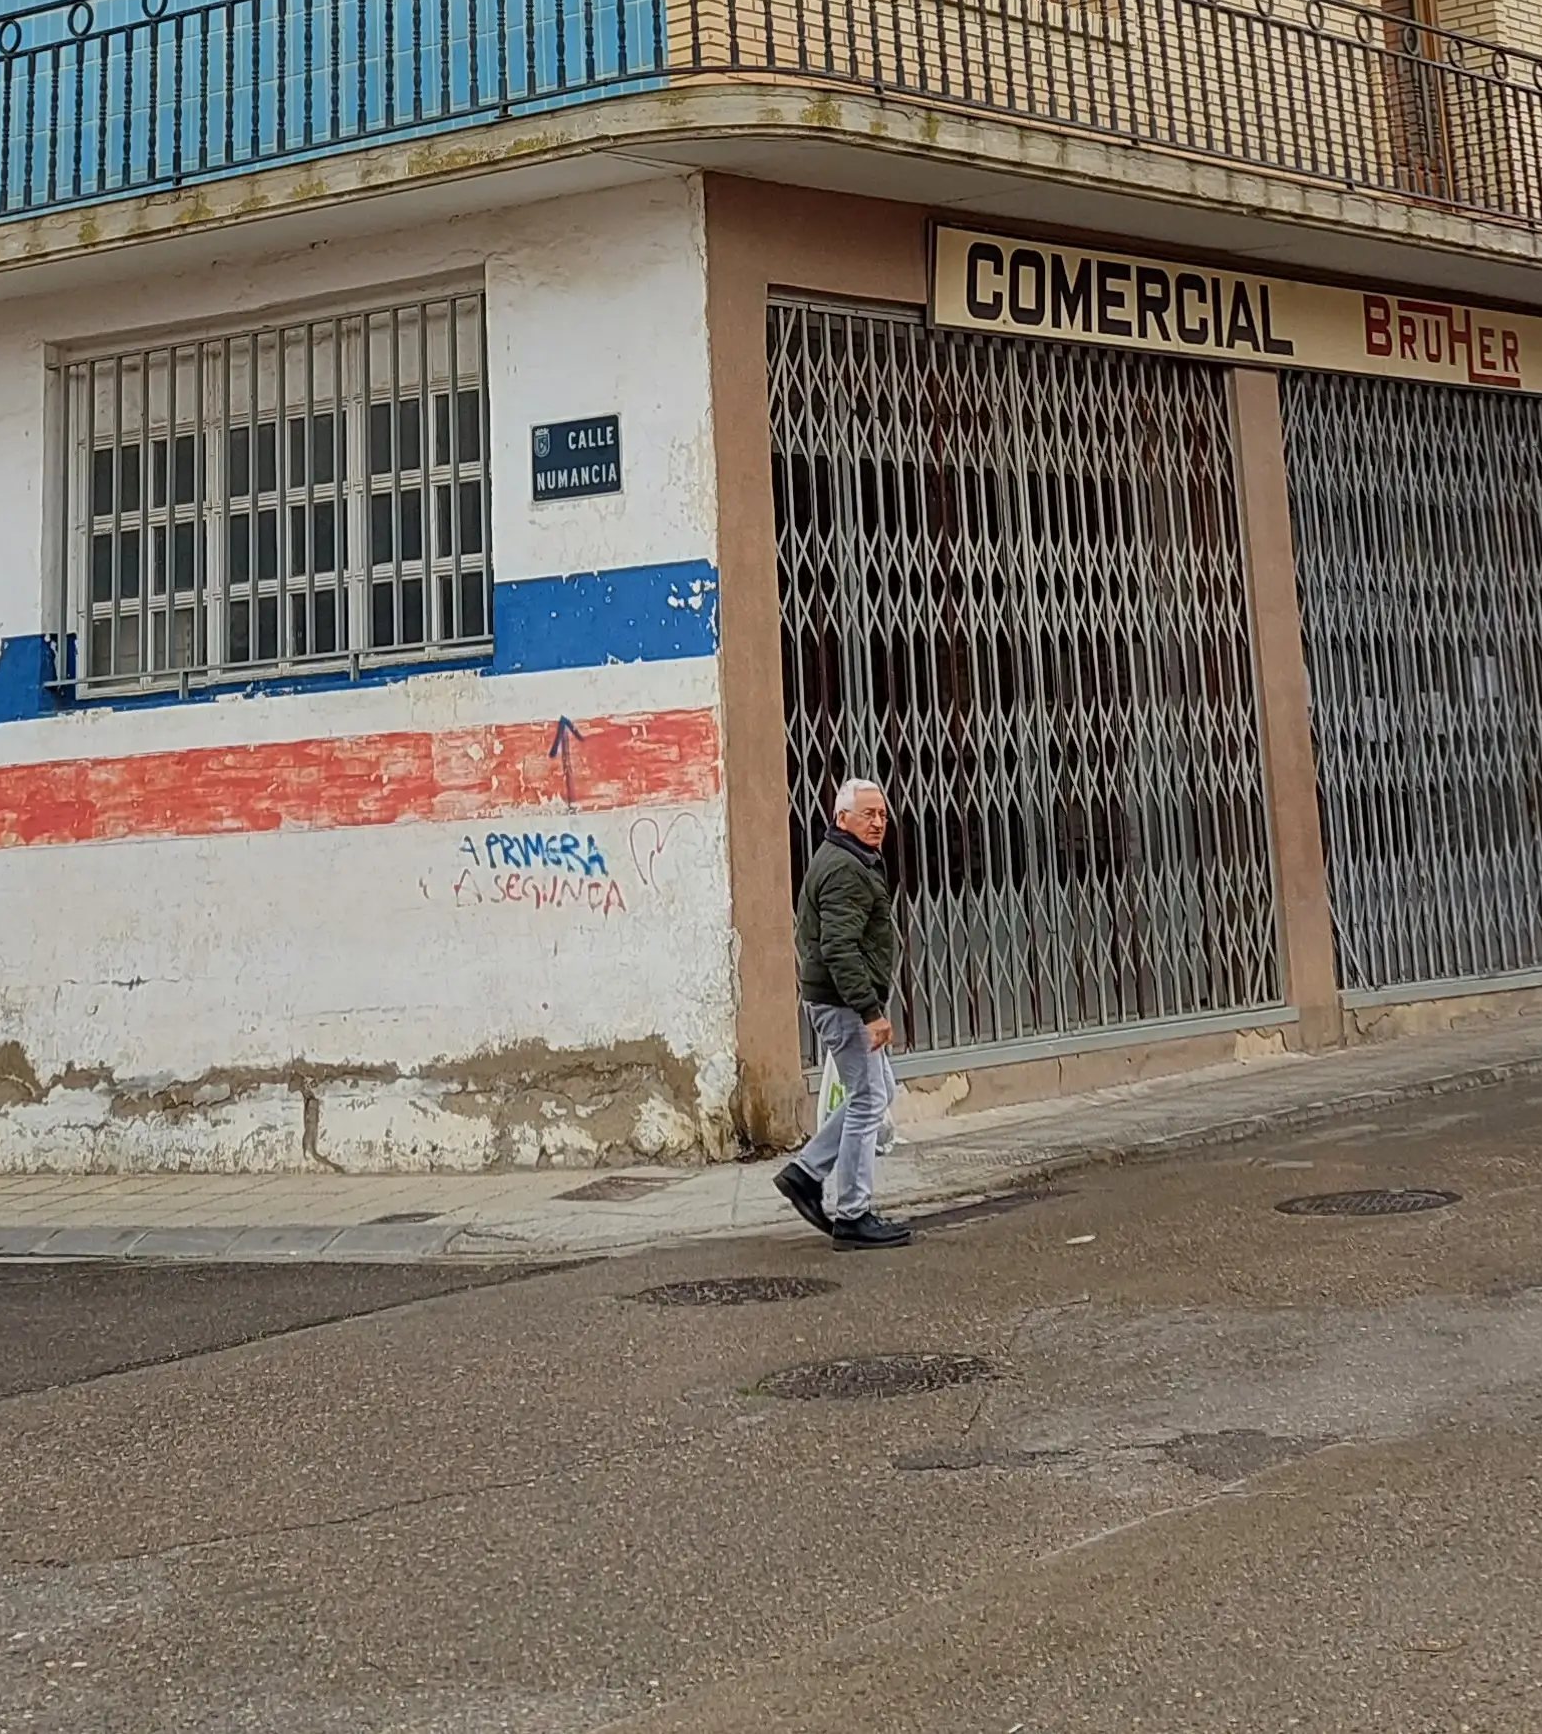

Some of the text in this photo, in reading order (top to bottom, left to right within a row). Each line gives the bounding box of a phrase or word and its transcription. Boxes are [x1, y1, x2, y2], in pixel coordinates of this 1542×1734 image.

[965, 241, 1294, 357] COMERCIAL
[567, 425, 615, 451] CALLE
[535, 462, 618, 492] NUMANCIA
